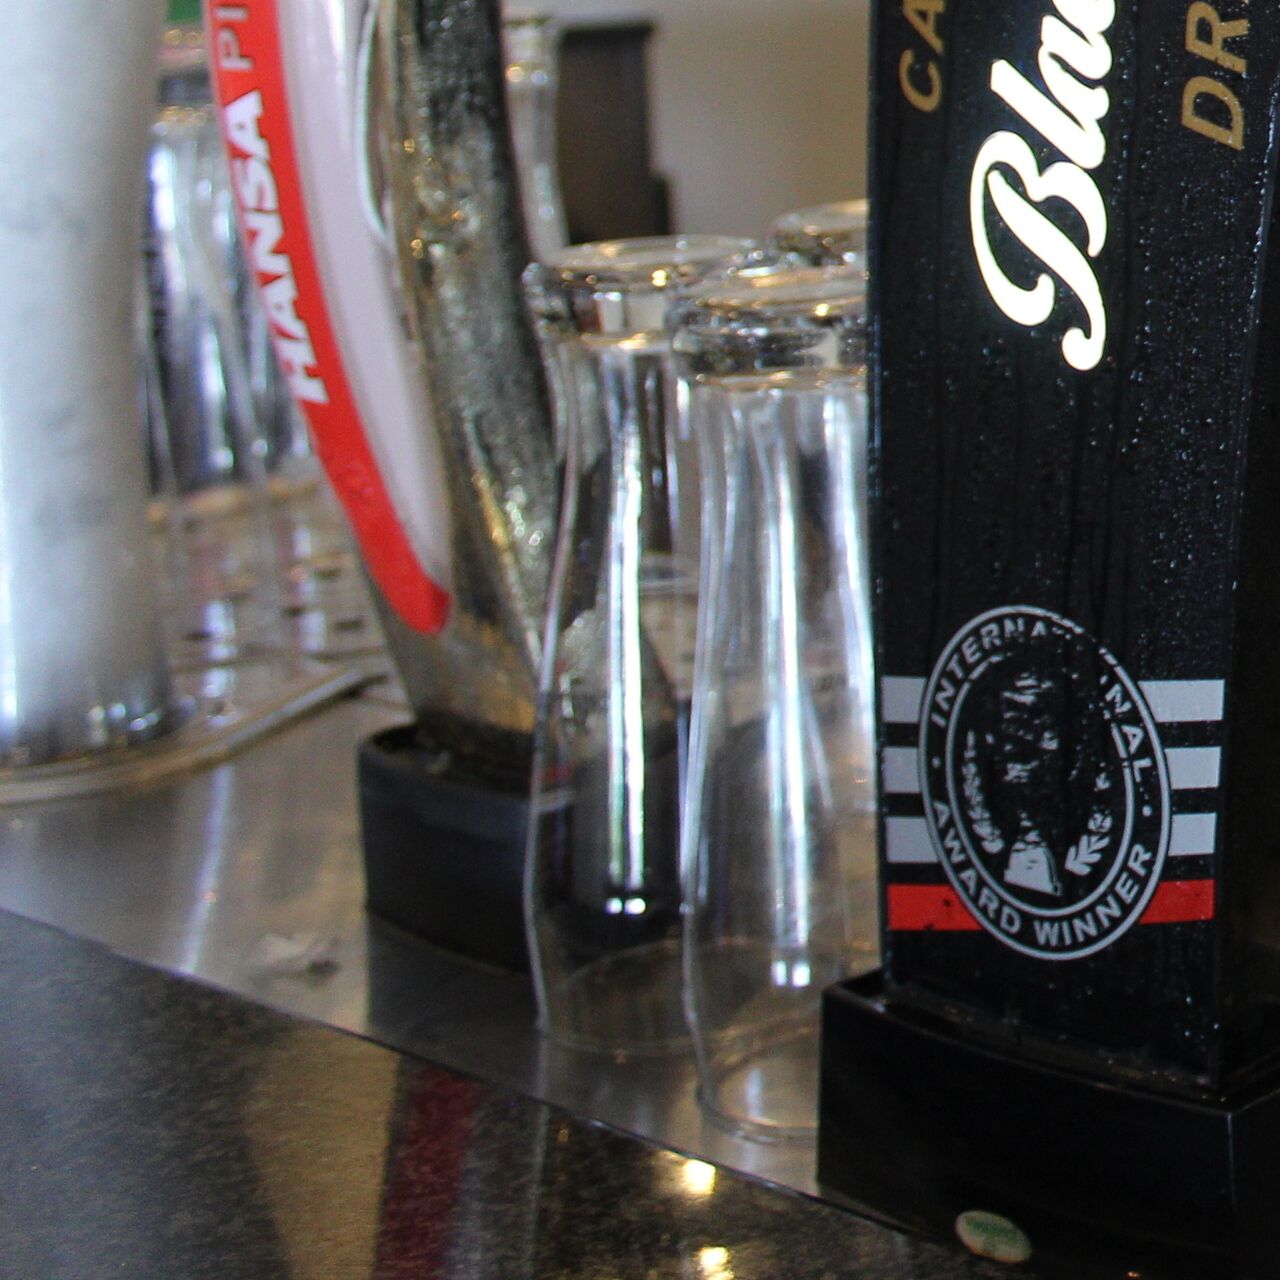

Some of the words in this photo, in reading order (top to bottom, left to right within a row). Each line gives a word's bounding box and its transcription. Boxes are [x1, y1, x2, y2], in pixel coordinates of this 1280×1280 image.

[224, 88, 329, 404] HANSA
[931, 617, 1153, 784] INTERNANAL
[933, 799, 1023, 936] AWARD
[1033, 842, 1152, 946] WINNER
